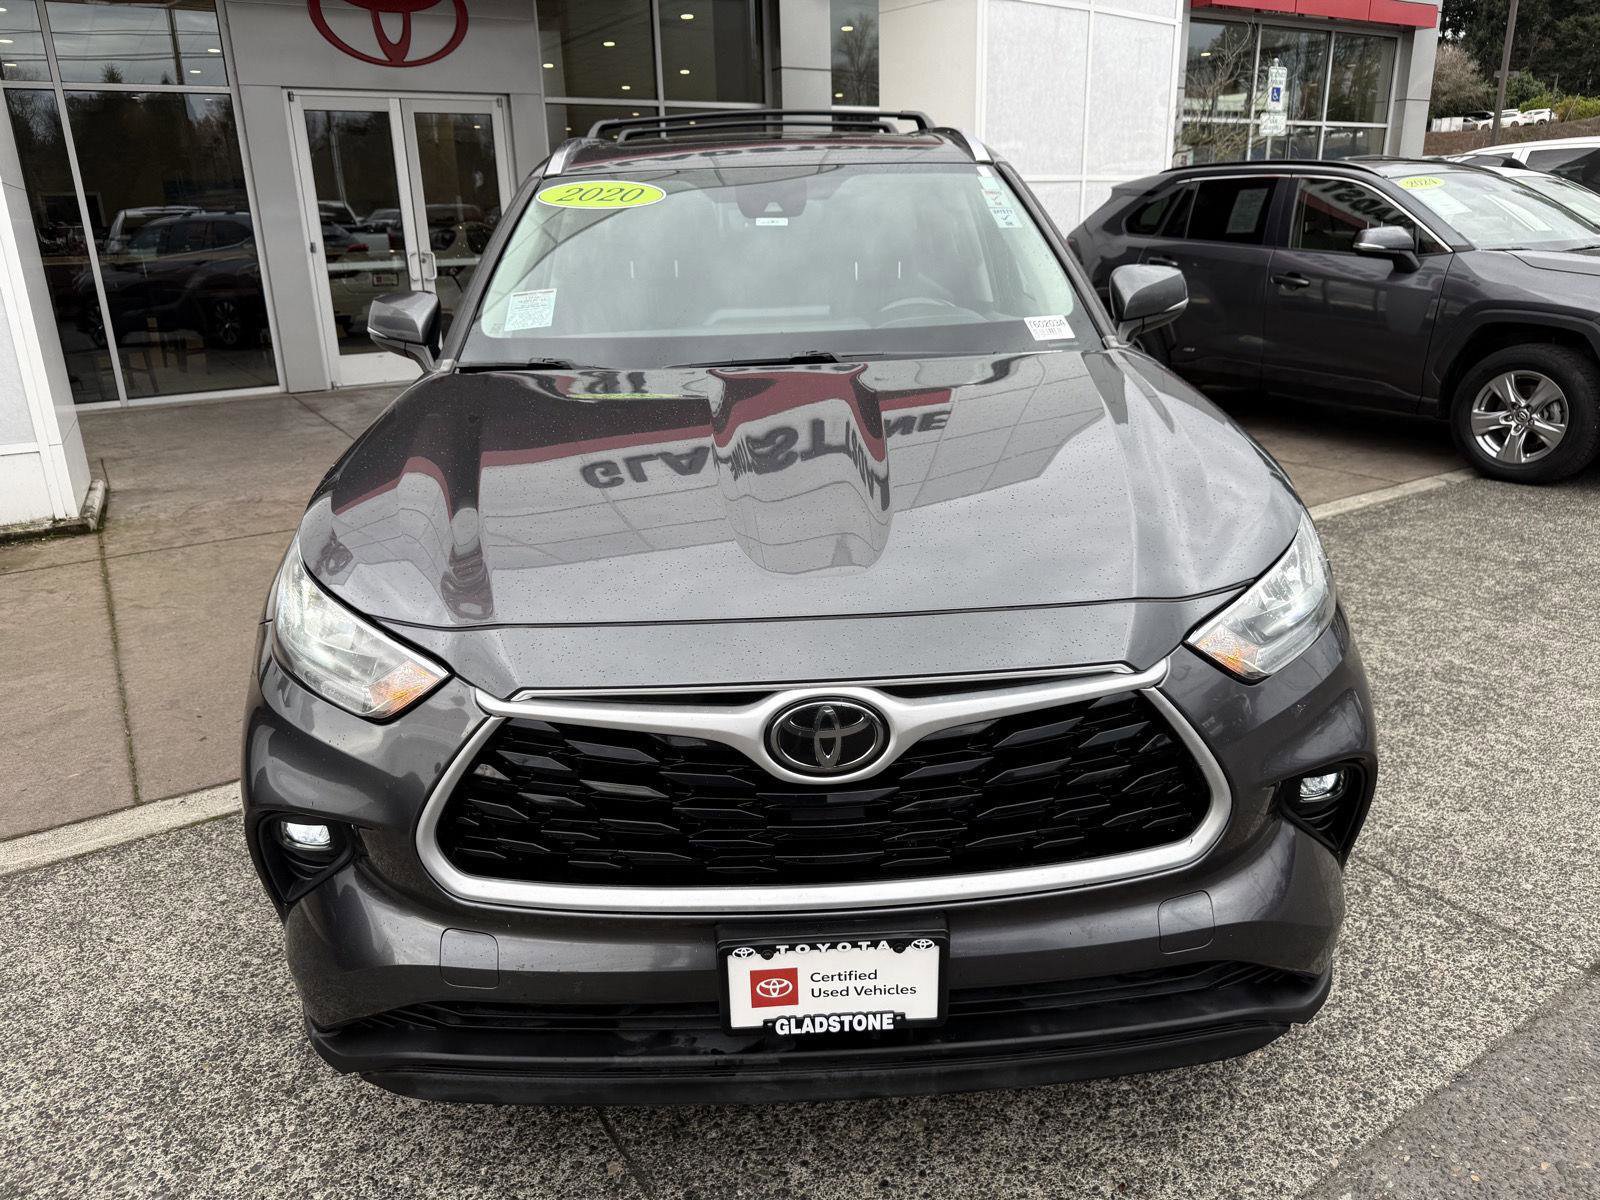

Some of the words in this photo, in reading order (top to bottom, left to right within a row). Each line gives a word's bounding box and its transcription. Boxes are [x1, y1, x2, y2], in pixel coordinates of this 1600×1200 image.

[554, 187, 645, 202] 2020
[776, 940, 890, 955] TOYOTA
[810, 969, 878, 983] Certified
[811, 986, 850, 999] Used
[854, 984, 917, 997] Vehicles
[775, 1012, 895, 1036] GLADSTONE
